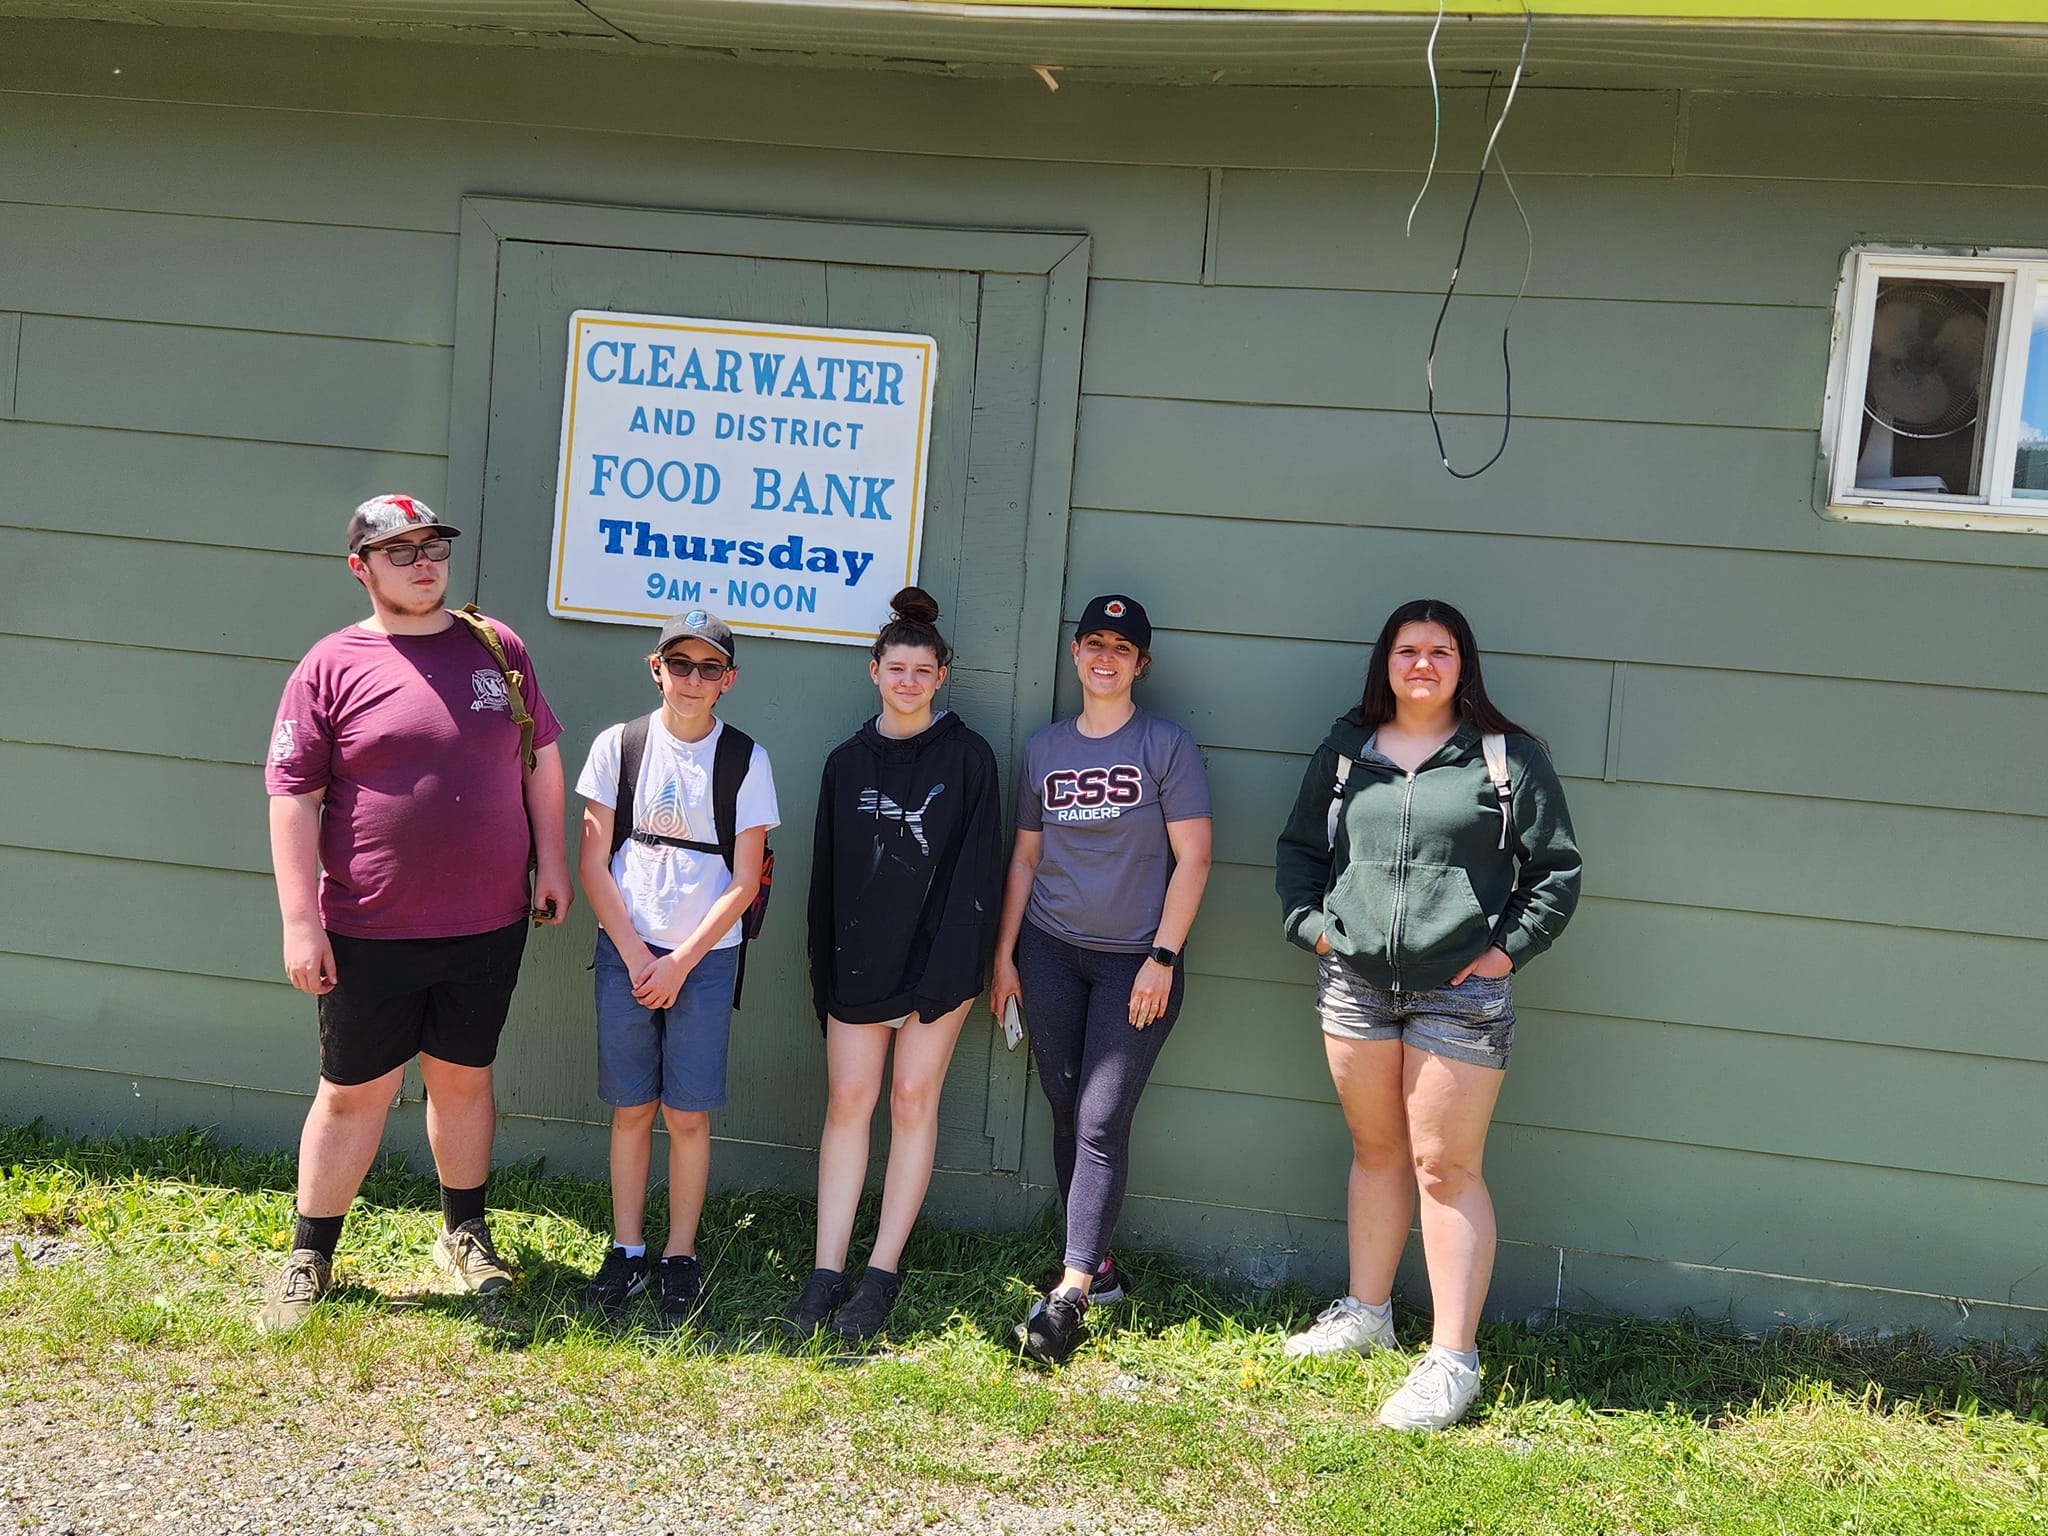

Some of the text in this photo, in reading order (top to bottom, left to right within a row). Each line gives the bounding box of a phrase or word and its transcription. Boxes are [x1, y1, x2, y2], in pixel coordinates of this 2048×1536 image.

[587, 341, 904, 406] CLEARWATER
[629, 406, 864, 450] AND DISTRICT
[589, 453, 896, 521] FOOD BANK
[598, 518, 875, 588] Thursday
[646, 572, 702, 604] 9AM
[726, 579, 817, 614] NOON
[1044, 764, 1143, 811] CSS
[1057, 806, 1121, 822] RAIDERS
